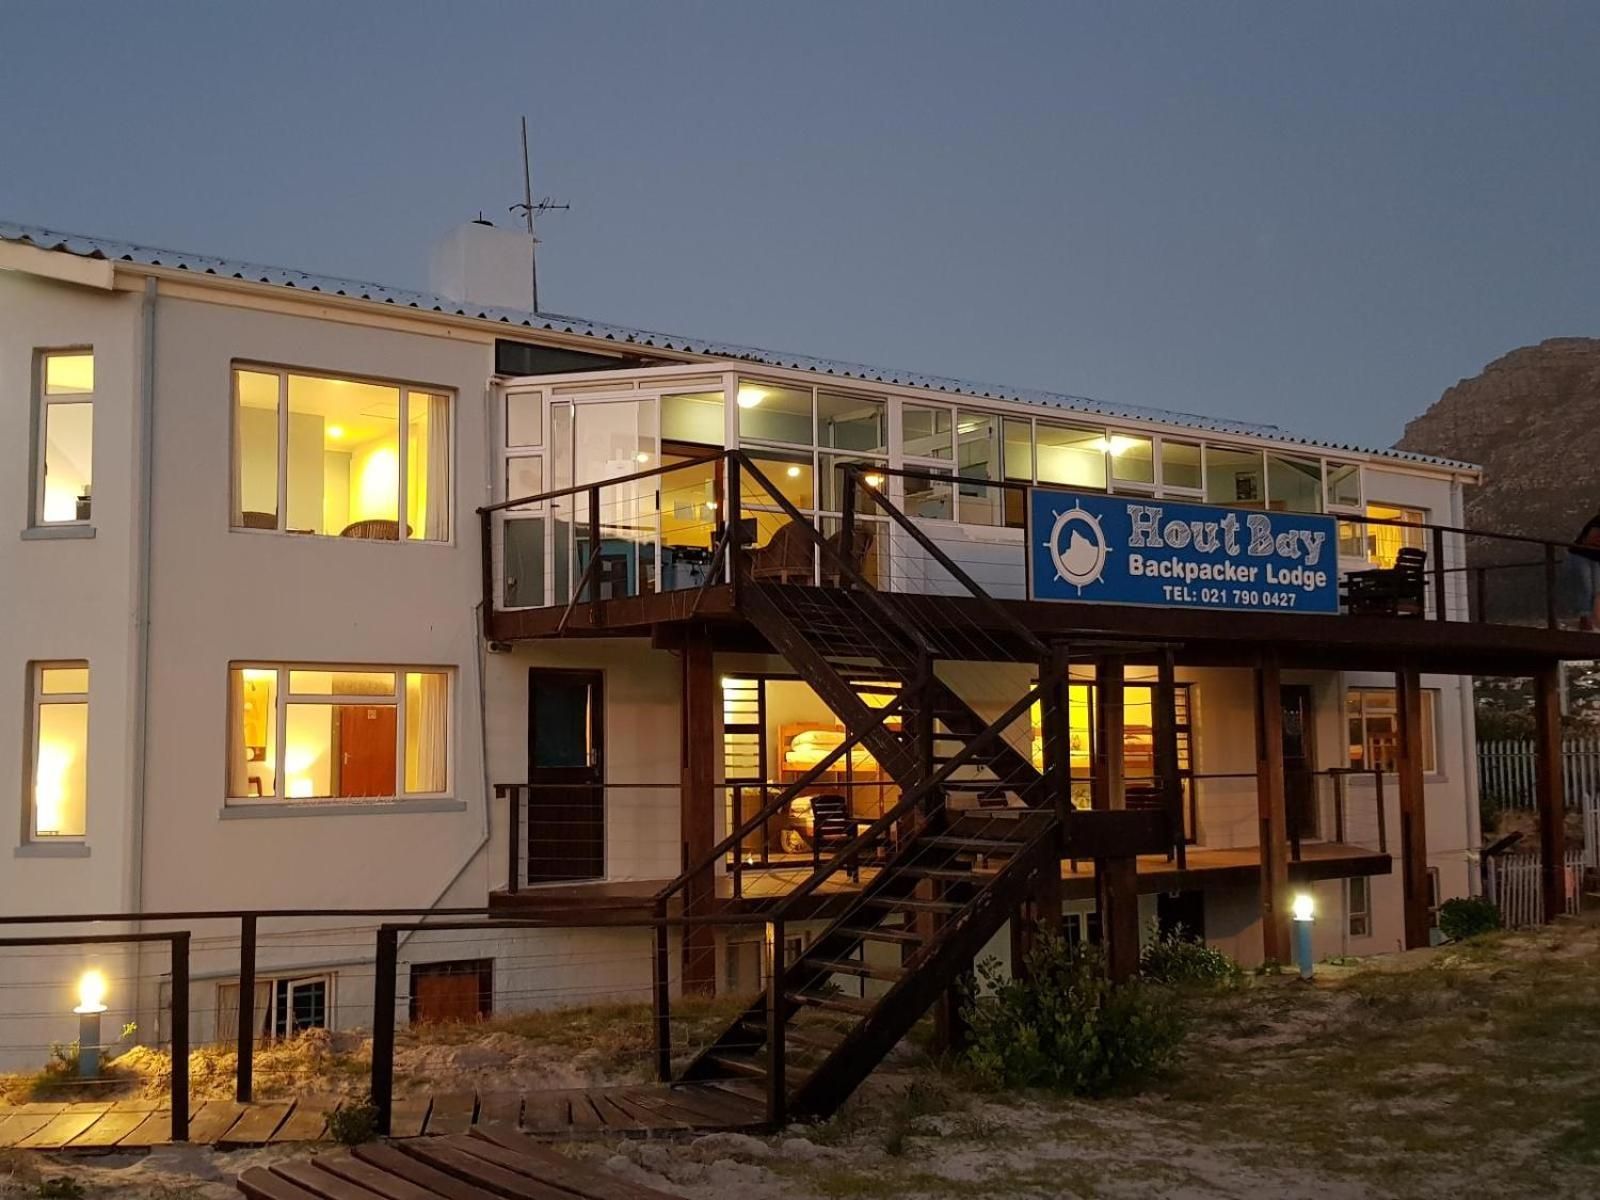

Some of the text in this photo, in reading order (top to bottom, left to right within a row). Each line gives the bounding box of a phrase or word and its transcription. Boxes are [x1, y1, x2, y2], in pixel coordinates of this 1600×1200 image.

[1126, 504, 1326, 566] Hout Bay
[1128, 554, 1327, 591] Backpacker Lodge
[1163, 586, 1296, 607] TEL: 021 790 0427
